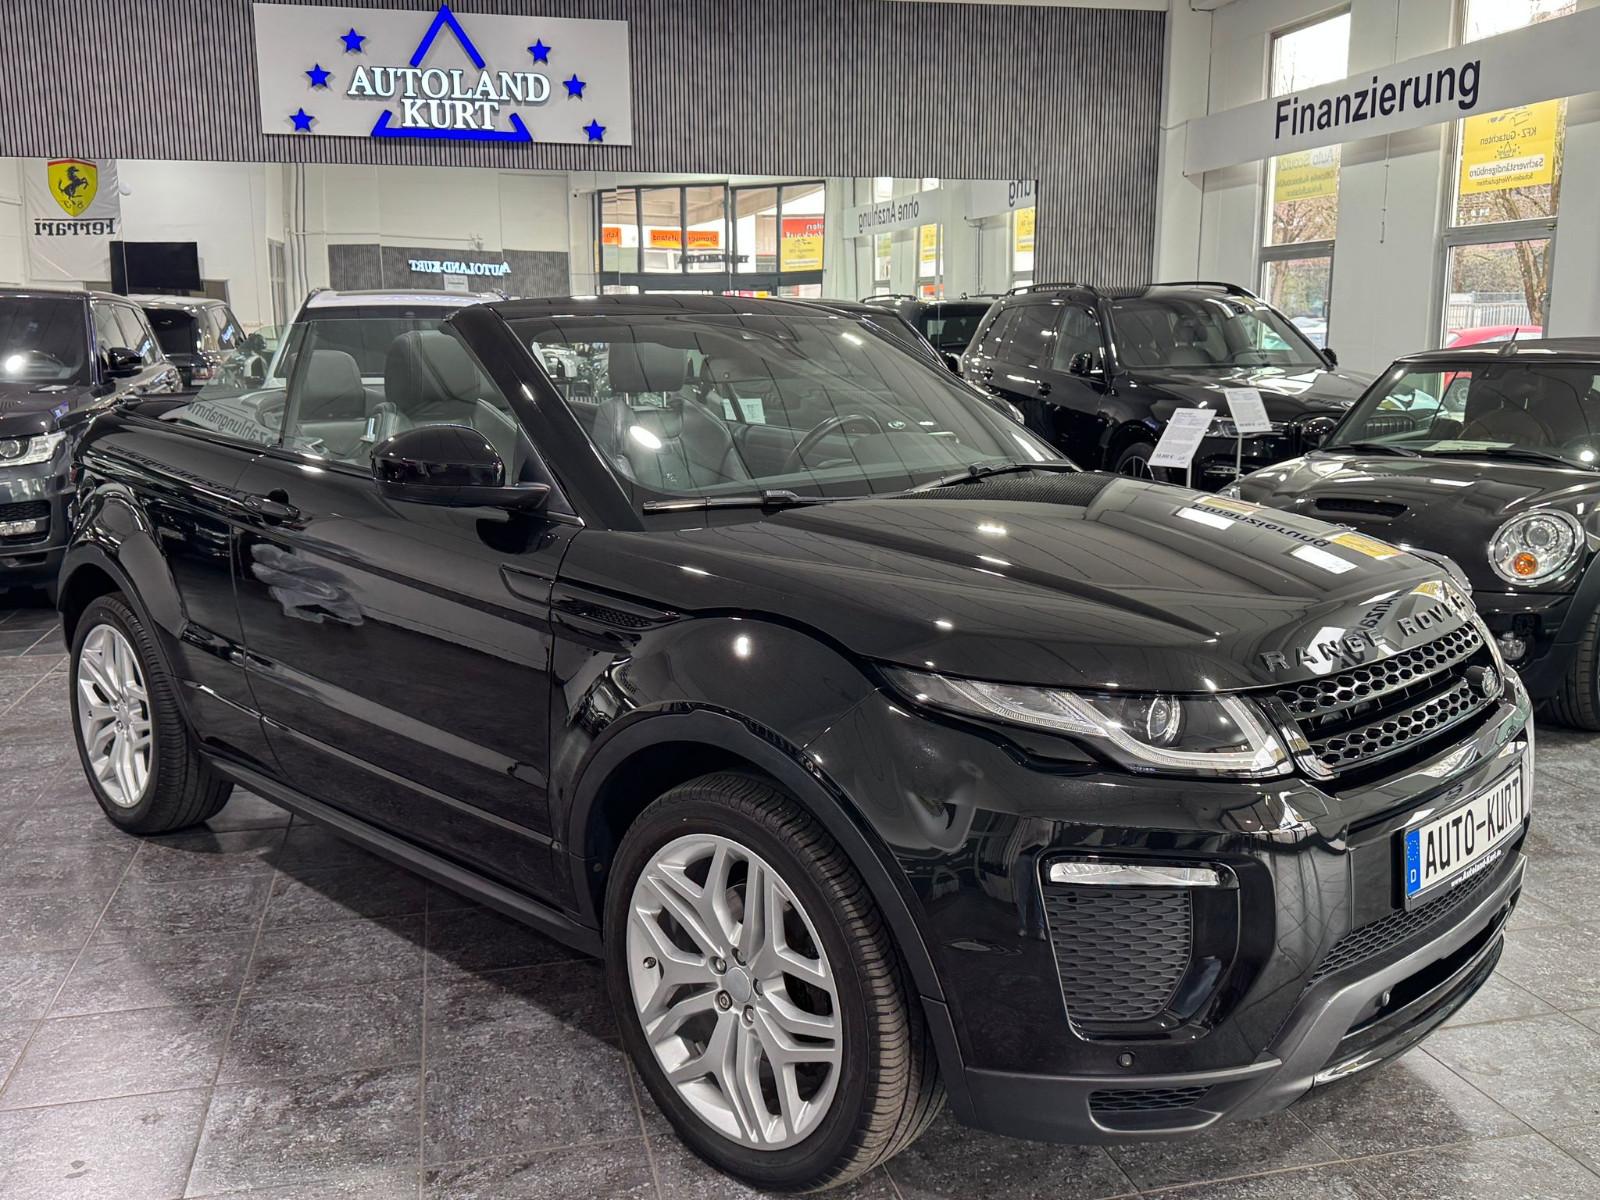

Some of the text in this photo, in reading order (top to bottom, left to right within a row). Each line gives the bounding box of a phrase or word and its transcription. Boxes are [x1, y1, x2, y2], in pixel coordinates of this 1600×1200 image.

[347, 66, 551, 104] AUTOLAND
[400, 98, 500, 131] KURT
[1274, 59, 1481, 140] Finanzierung
[1260, 627, 1387, 675] RANGE
[1397, 594, 1470, 638] ROVER
[1425, 776, 1520, 879] AUTO-KURT
[1410, 868, 1417, 884] D
